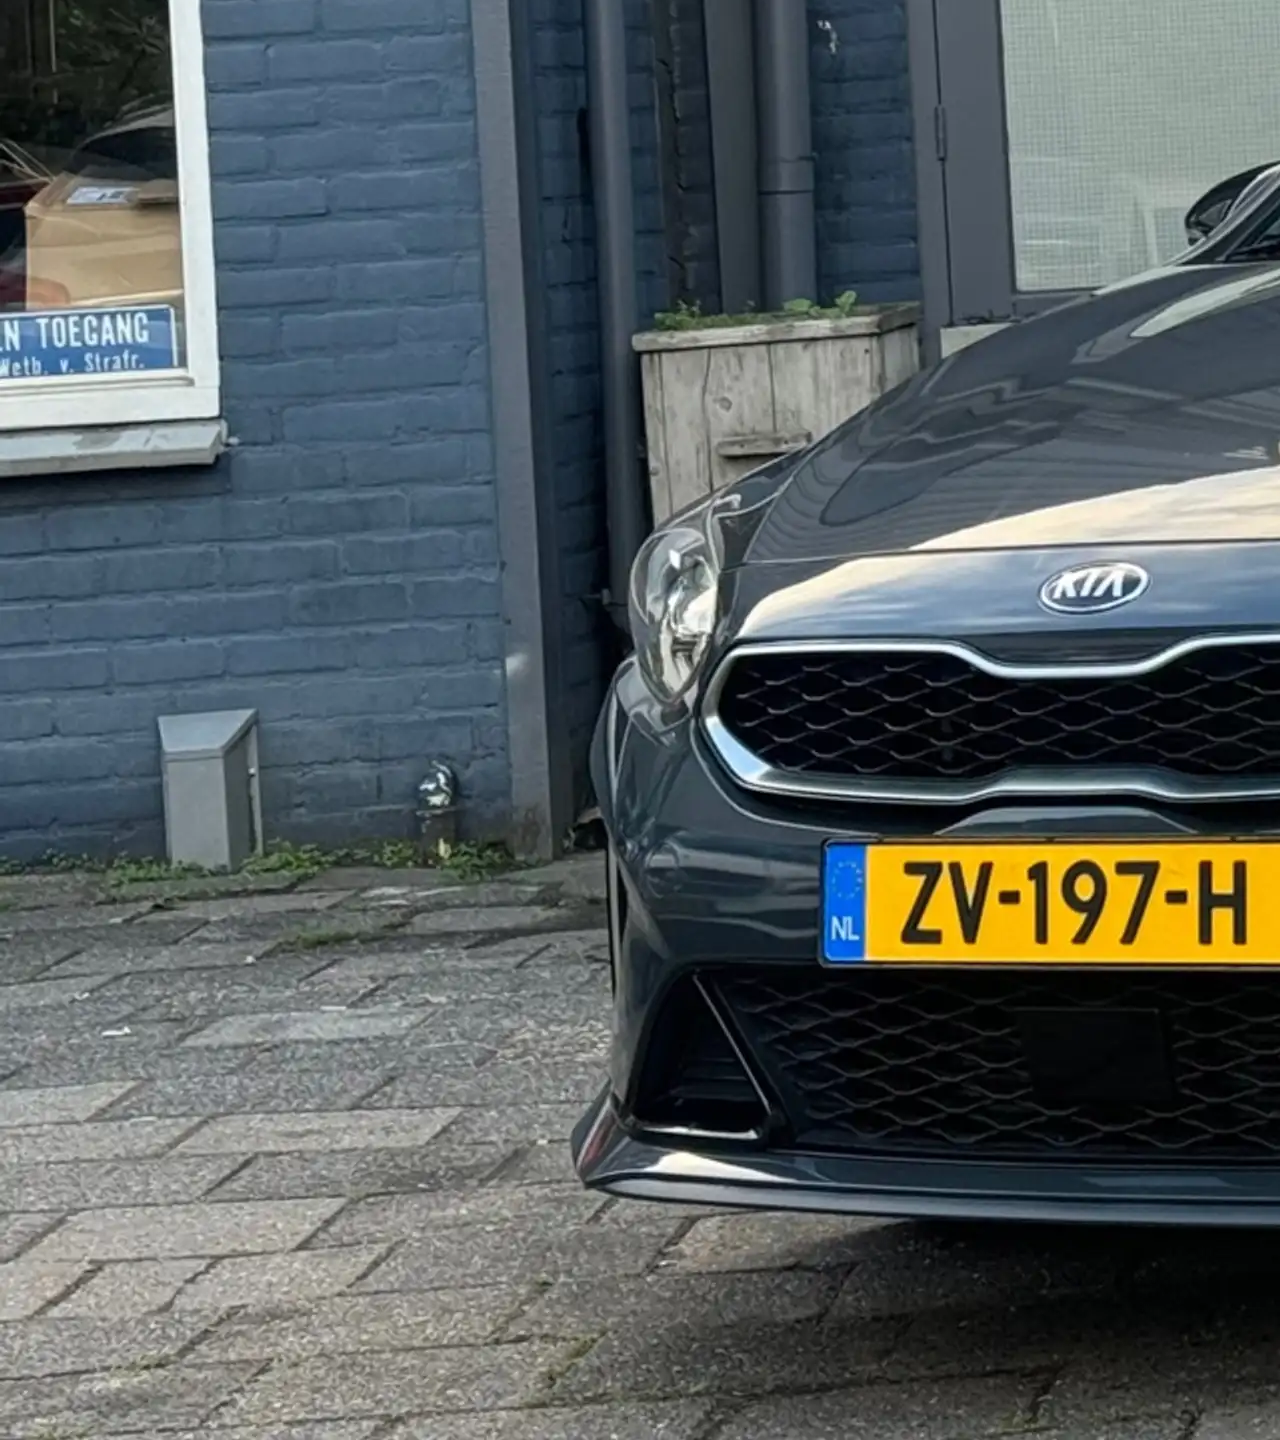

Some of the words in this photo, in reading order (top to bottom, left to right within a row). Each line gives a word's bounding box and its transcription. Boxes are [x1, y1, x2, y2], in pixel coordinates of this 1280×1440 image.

[0, 319, 21, 352] N
[36, 312, 150, 349] TOEGANG
[59, 359, 75, 373] v.
[1051, 567, 1126, 599] KIA
[899, 859, 1249, 946] ZV-197-H
[830, 914, 860, 942] NL
